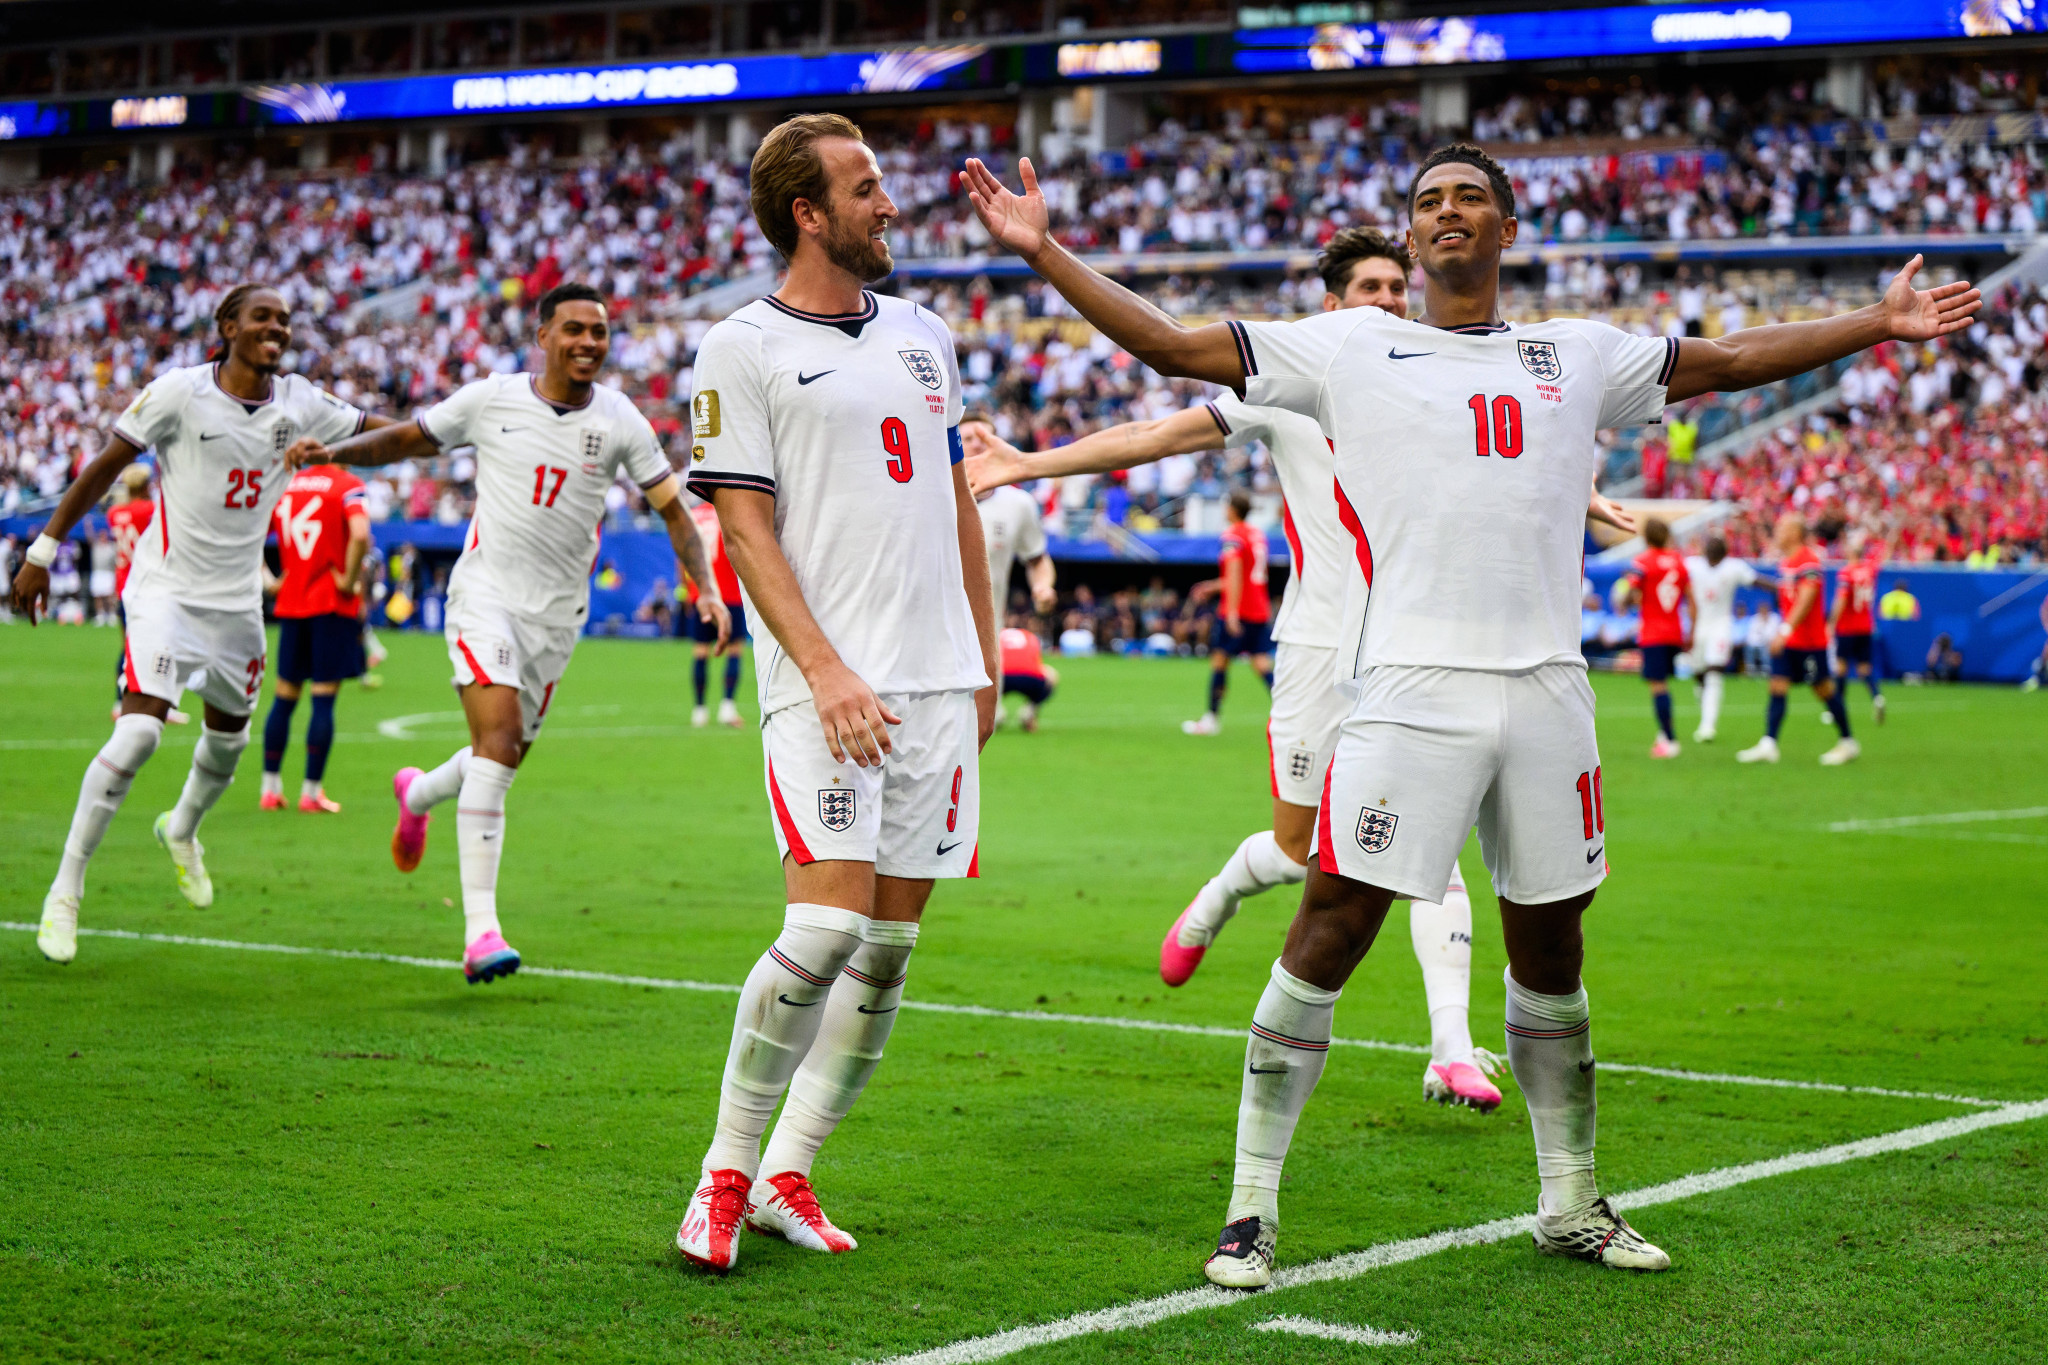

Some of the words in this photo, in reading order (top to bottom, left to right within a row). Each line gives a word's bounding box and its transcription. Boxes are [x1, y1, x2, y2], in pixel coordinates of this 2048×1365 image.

[1536, 384, 1561, 394] NORWAY
[880, 416, 913, 483] 9
[1468, 394, 1523, 458] 10
[225, 468, 263, 509] 25
[532, 464, 568, 508] 17
[276, 494, 323, 560] 16
[1656, 568, 1681, 614] 6
[946, 764, 963, 833] 9
[1575, 765, 1605, 841] 10
[1450, 931, 1471, 946] EN
